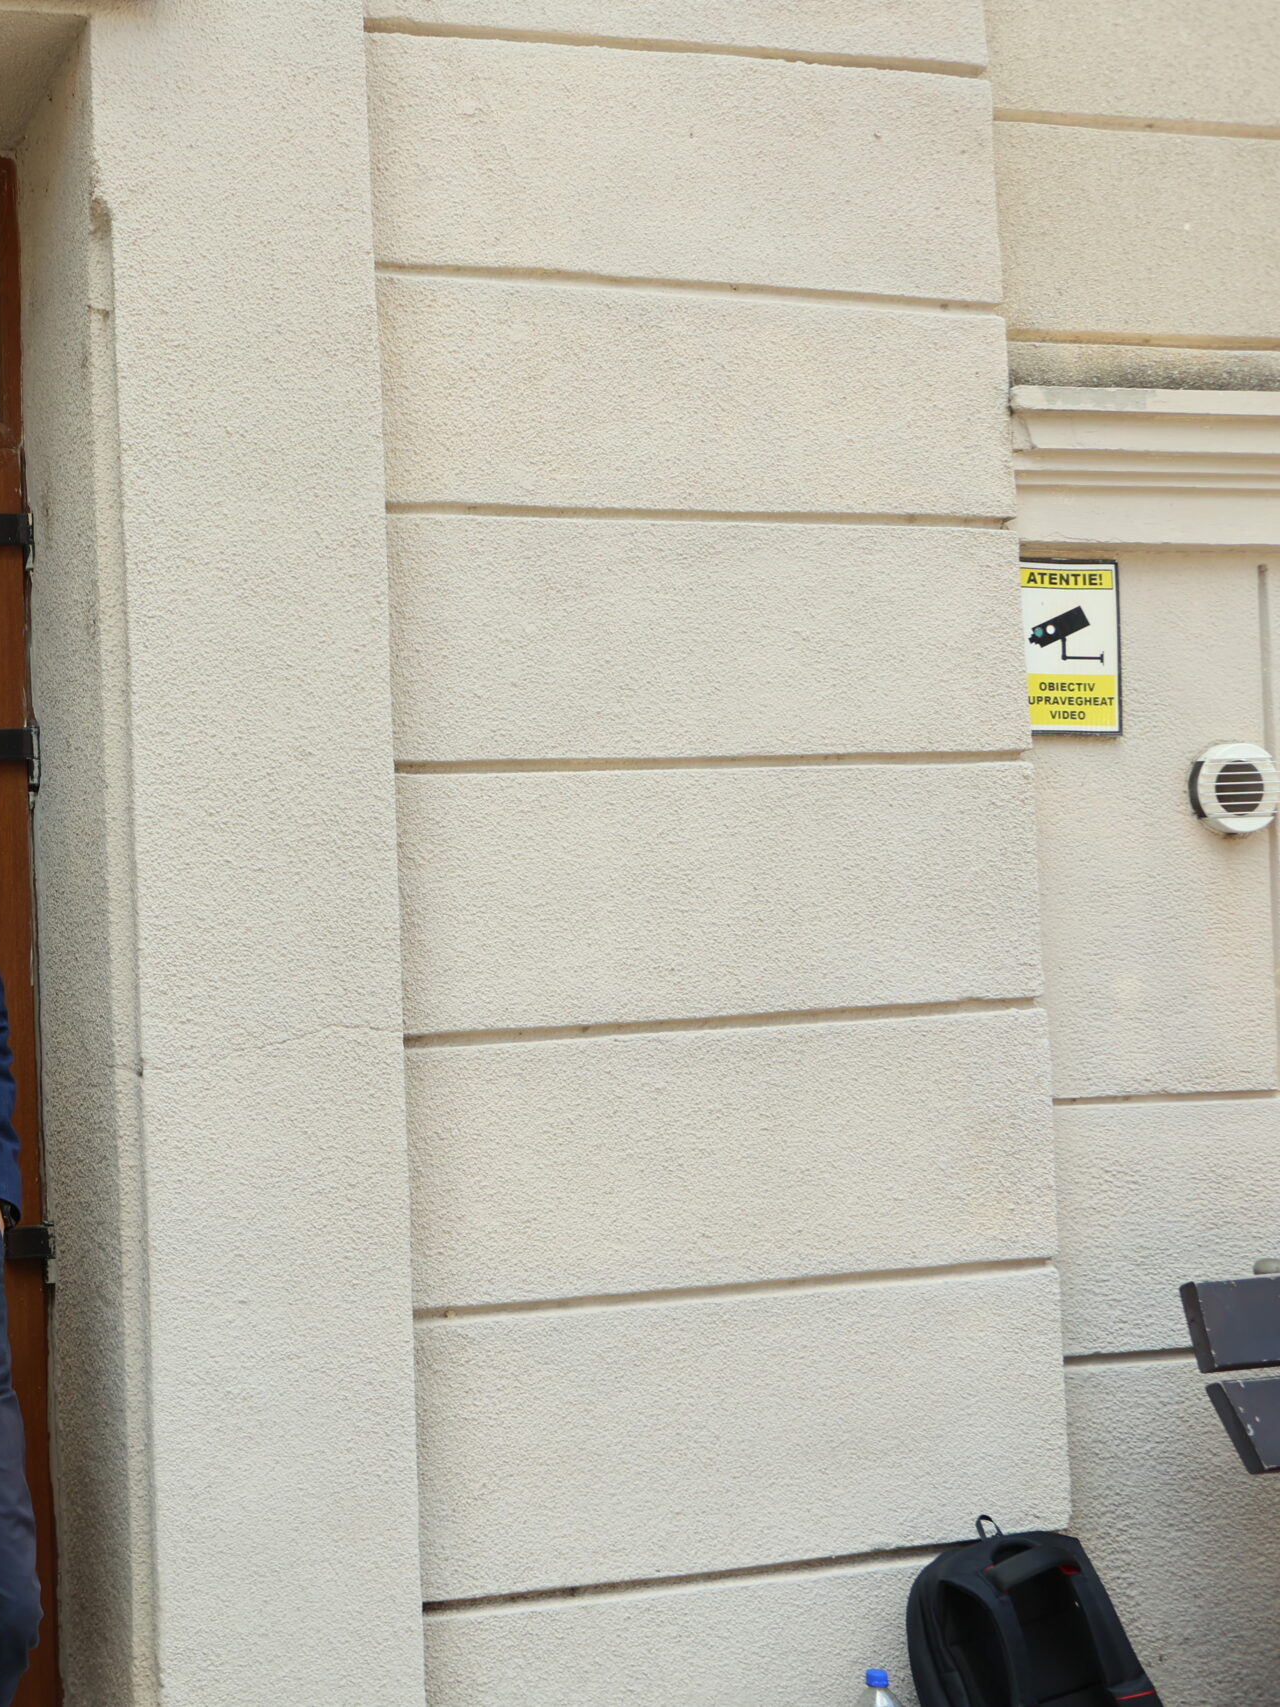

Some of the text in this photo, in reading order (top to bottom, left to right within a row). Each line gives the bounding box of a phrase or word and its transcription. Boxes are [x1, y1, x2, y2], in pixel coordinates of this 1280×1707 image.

[1026, 571, 1103, 586] ATENTIE!
[1038, 681, 1096, 692] OBIECTIV
[1027, 695, 1115, 706] UPRAVEGHEAT
[1049, 710, 1086, 720] VIDEO
